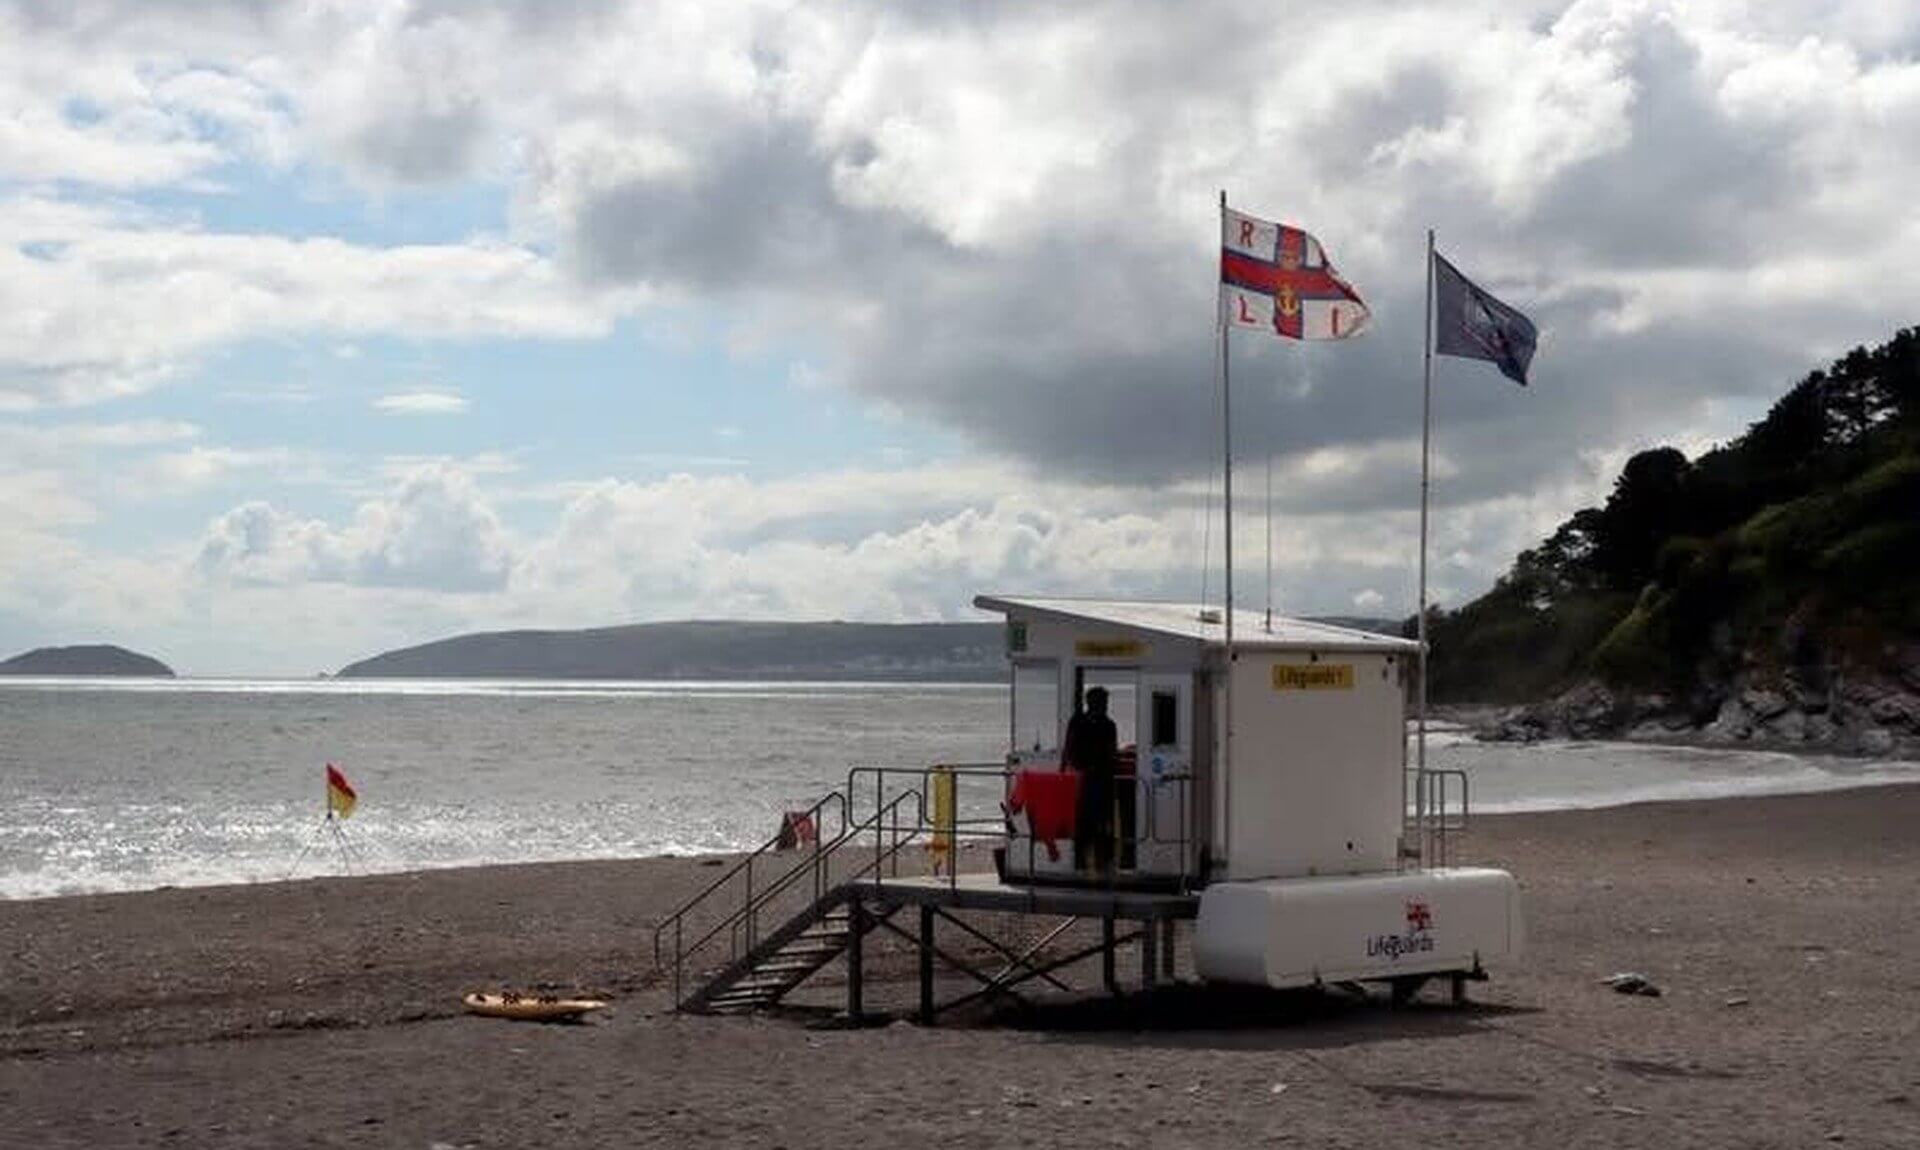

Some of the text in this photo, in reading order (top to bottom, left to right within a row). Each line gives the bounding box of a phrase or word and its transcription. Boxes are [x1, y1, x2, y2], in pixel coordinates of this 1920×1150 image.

[1240, 219, 1255, 248] R
[1239, 294, 1339, 336] L I
[1366, 934, 1434, 960] Lifeguards
